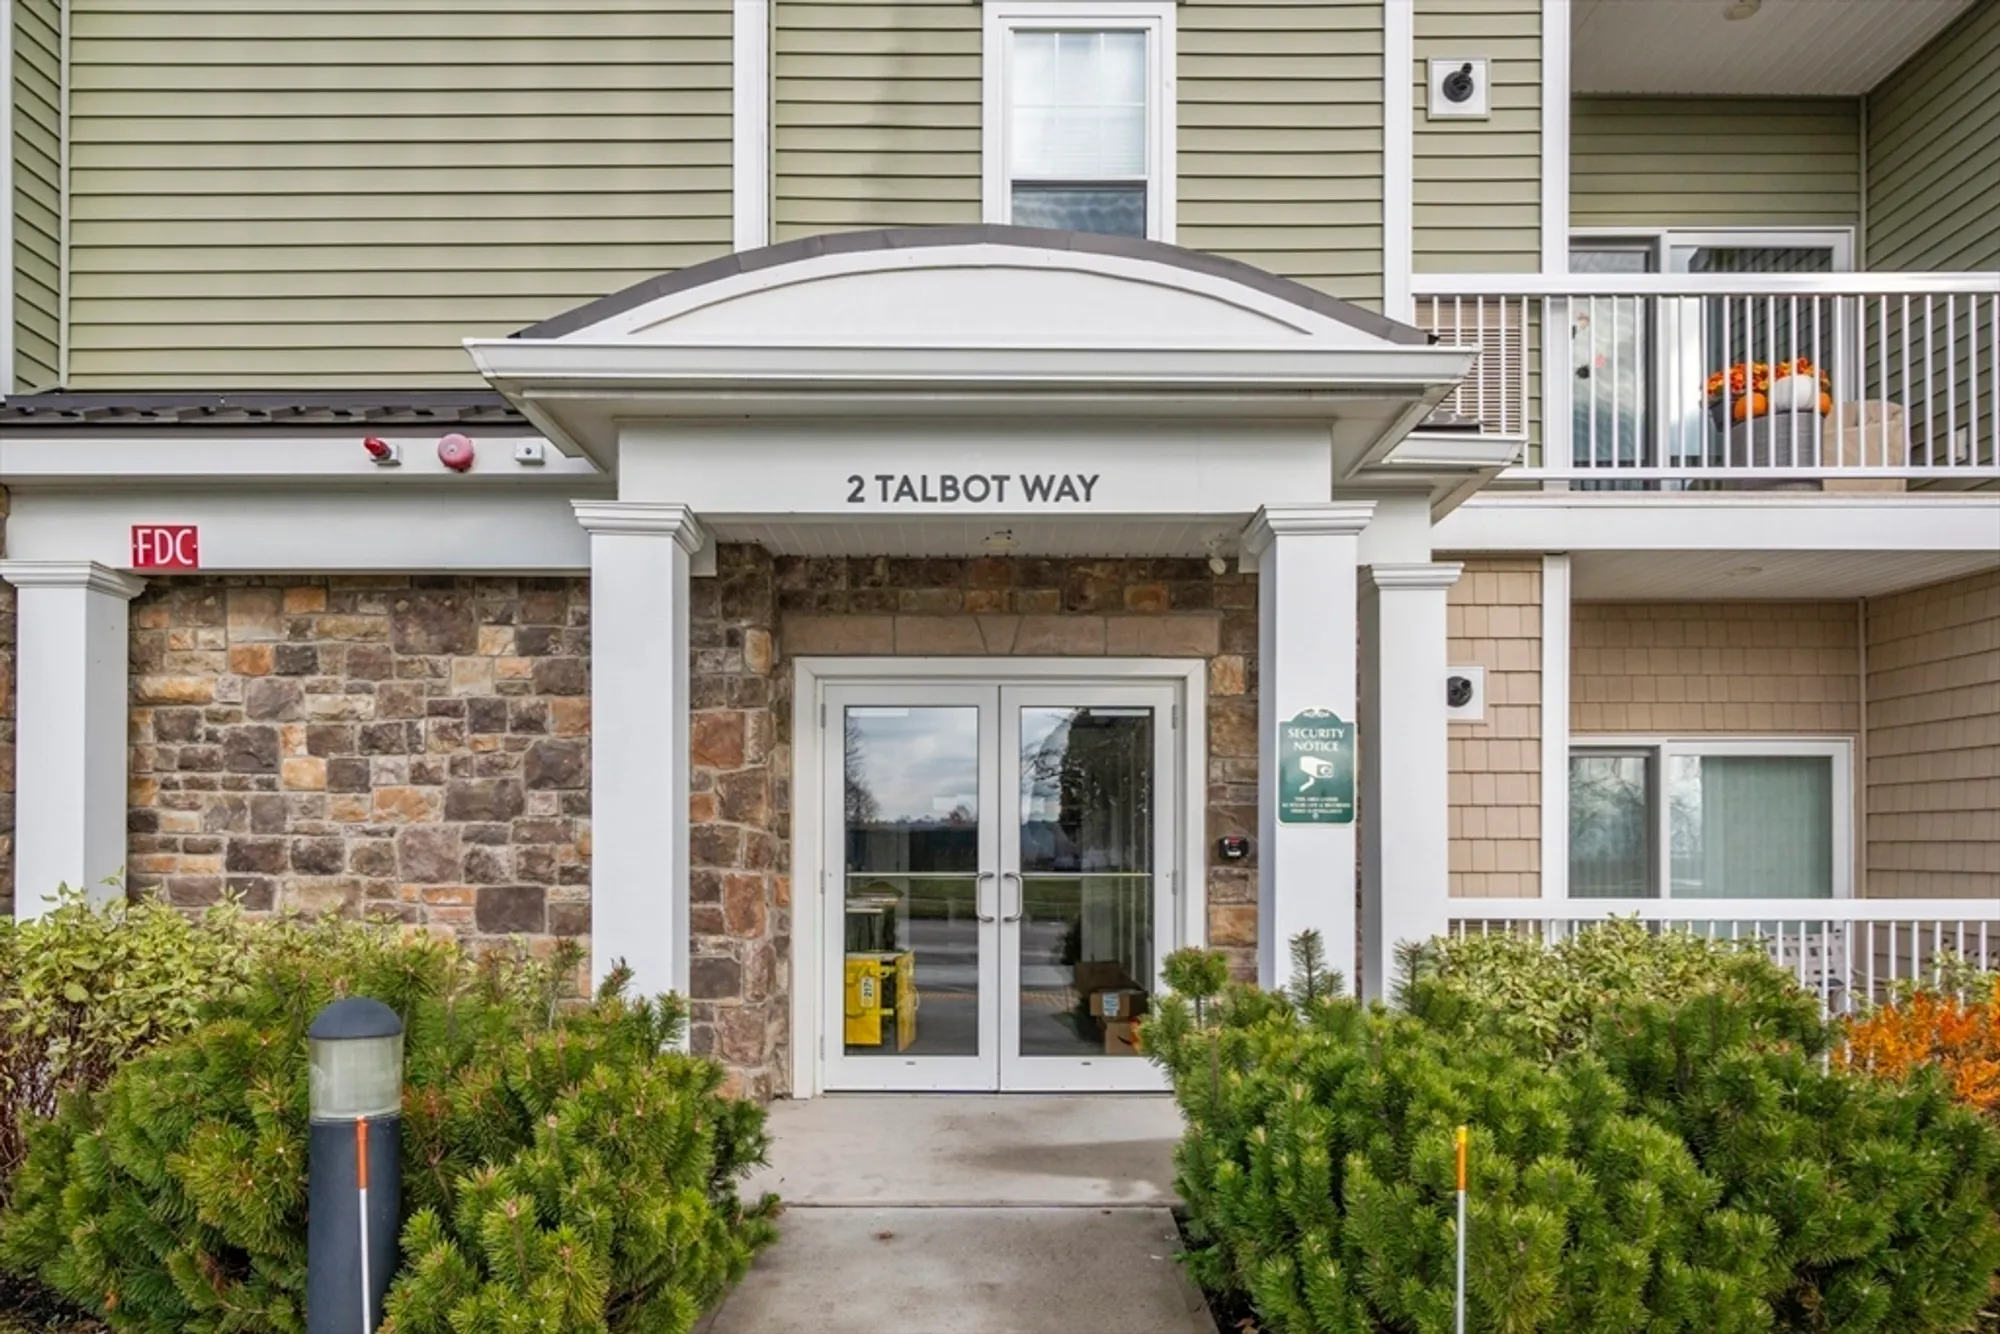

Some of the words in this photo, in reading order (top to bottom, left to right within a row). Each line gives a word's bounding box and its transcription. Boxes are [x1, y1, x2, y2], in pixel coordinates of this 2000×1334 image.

[847, 474, 865, 503] 2
[875, 474, 1011, 503] TALBOT
[1019, 474, 1100, 503] WAY
[138, 529, 193, 565] FDC
[1288, 727, 1345, 739] SECURITY
[1293, 740, 1339, 752] NOTICE
